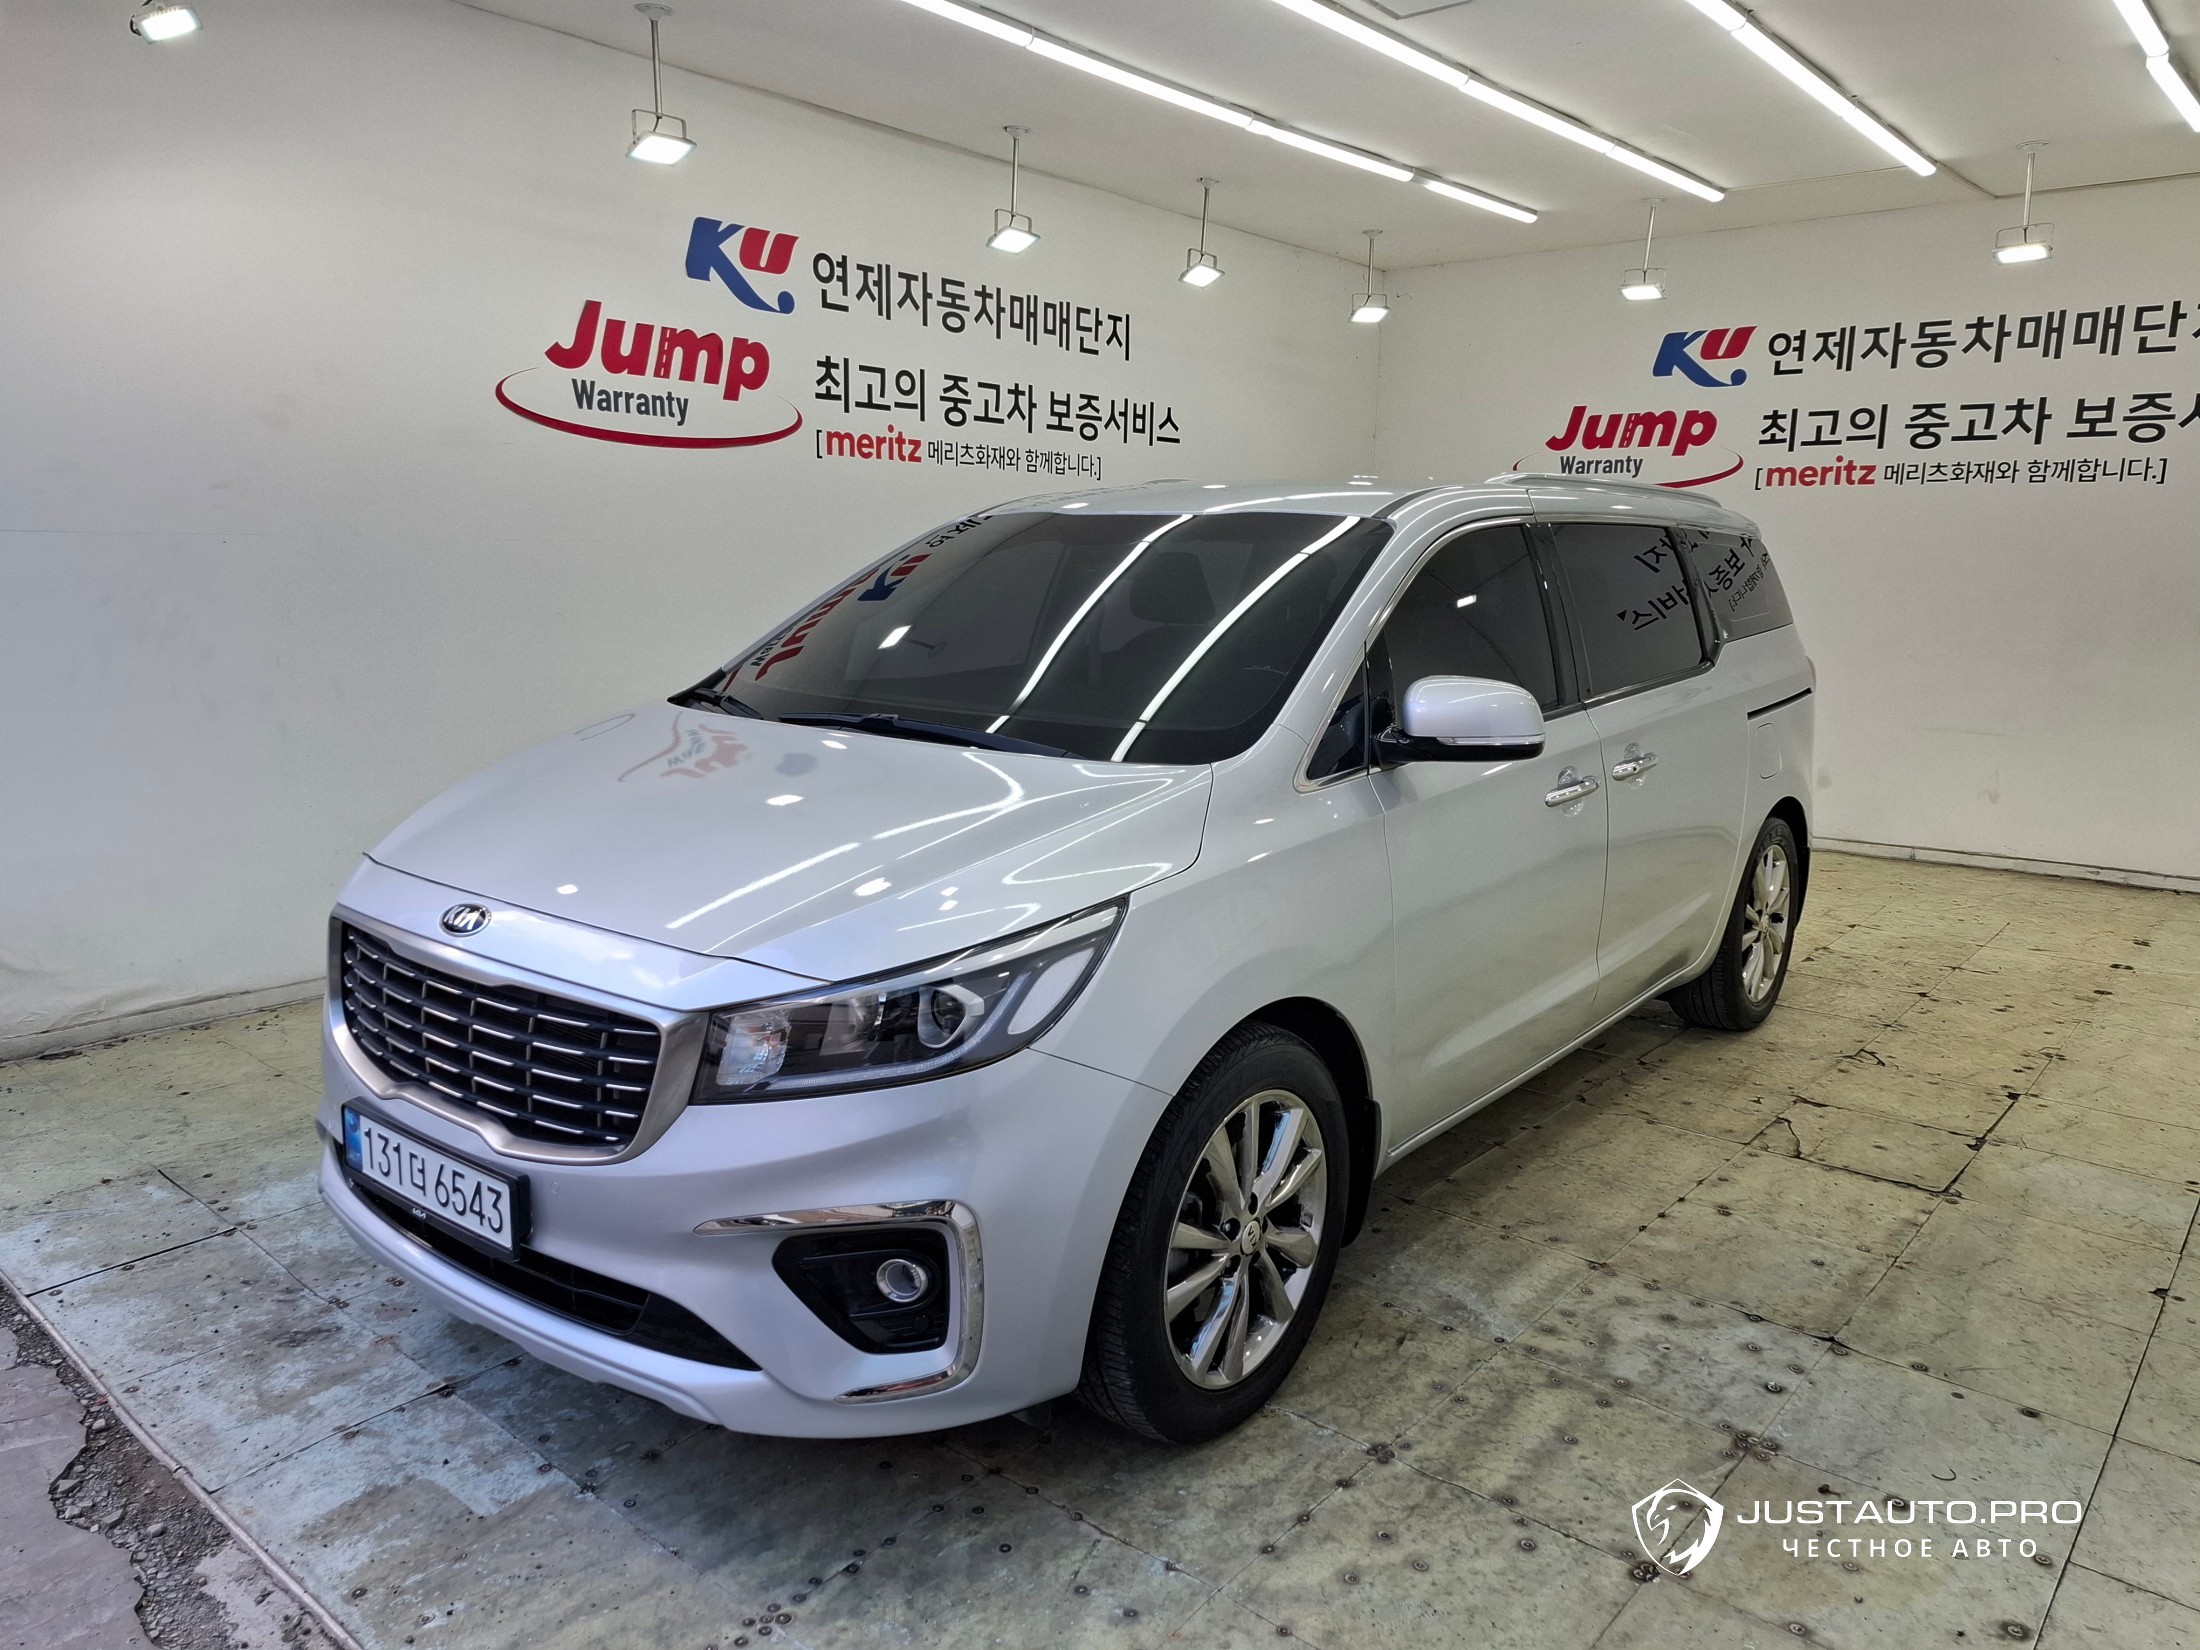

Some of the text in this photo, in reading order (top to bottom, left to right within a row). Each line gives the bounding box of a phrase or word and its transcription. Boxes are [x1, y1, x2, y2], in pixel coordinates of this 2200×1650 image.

[812, 252, 1130, 361] 연제자동차매매단지
[544, 299, 770, 401] Jump
[571, 378, 688, 426] Warranty
[814, 355, 1181, 446] 최고의 중고차 보증서비스
[1758, 404, 1889, 453] 최고의
[1904, 396, 2053, 449] 중고차
[1545, 405, 1718, 457] Jump
[927, 439, 1021, 472] 메리츠화재와
[1024, 447, 1102, 480] 함께합니다.]
[1559, 455, 1644, 479] Warranty
[1884, 459, 2020, 486] 메리츠화재와
[2027, 457, 2168, 485] 함께합니다.]
